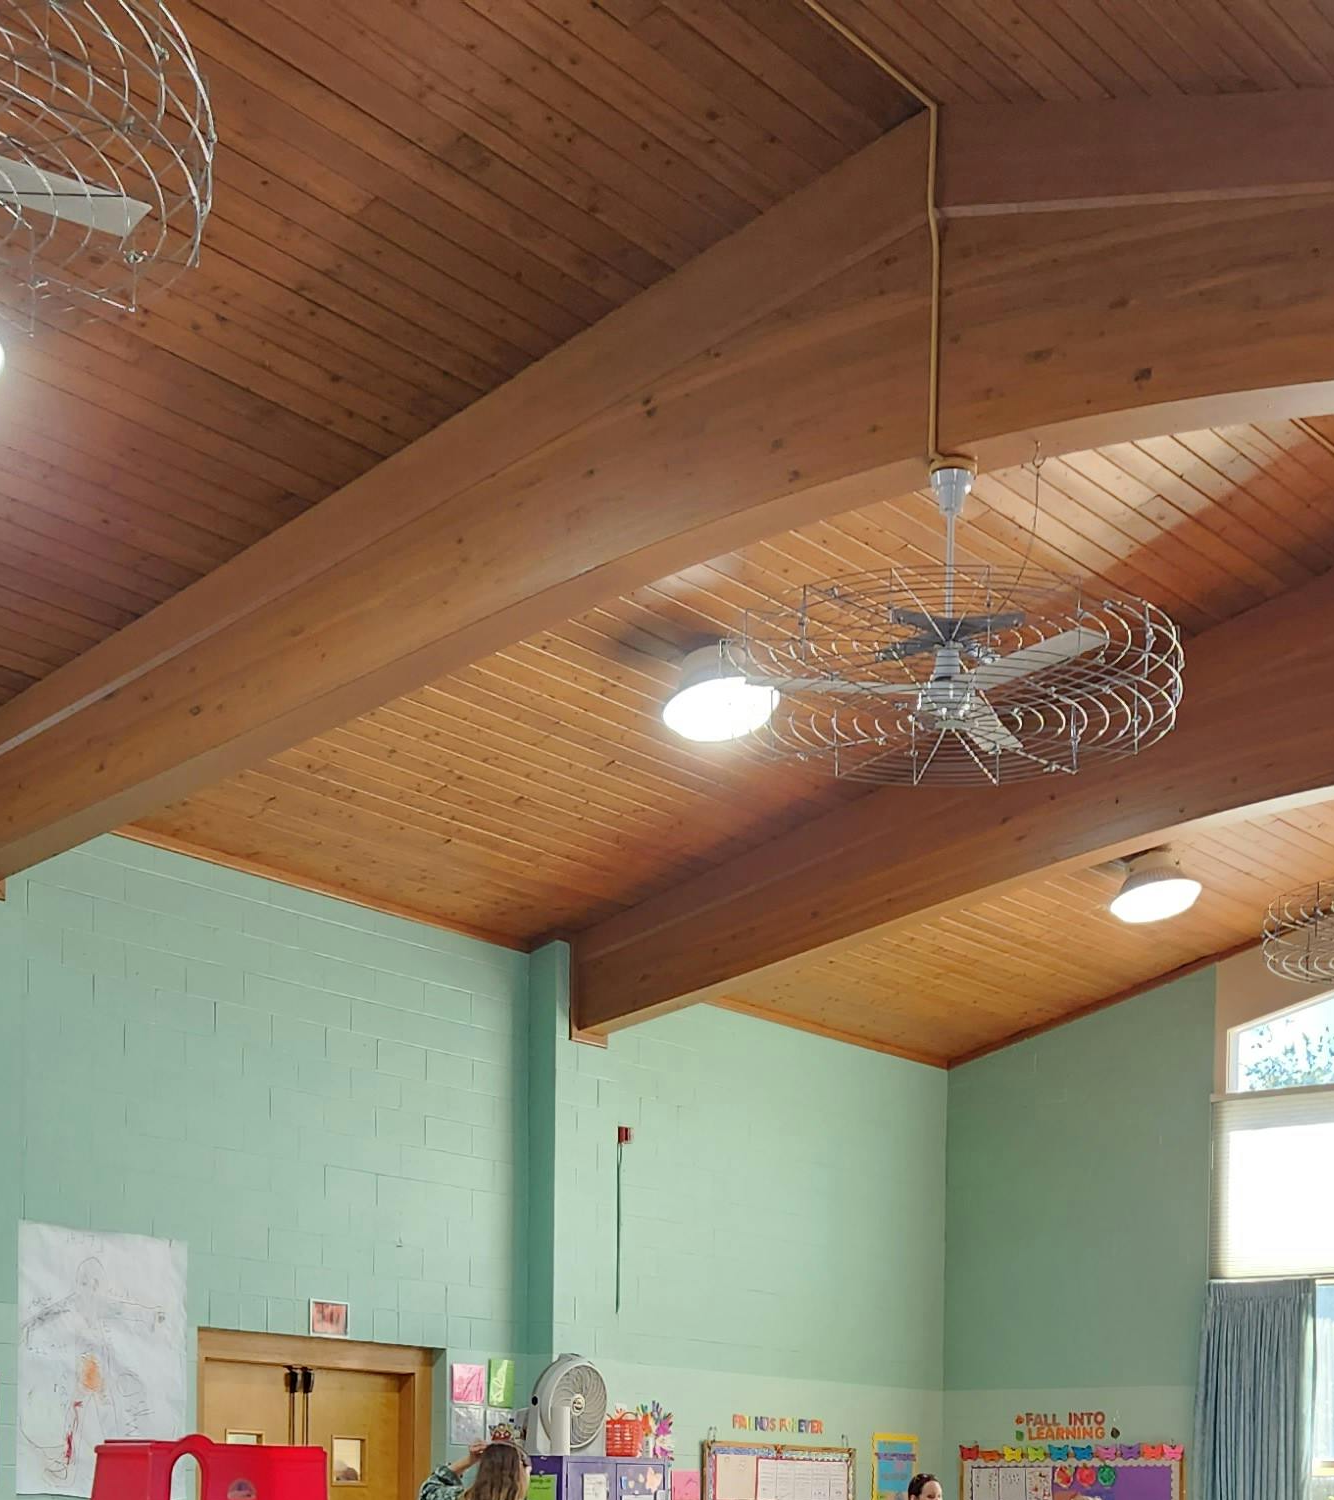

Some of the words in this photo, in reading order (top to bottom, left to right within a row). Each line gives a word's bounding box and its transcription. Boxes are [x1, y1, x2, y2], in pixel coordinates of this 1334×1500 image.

[1025, 1412, 1061, 1427] FALL
[1068, 1411, 1106, 1426] INTO
[1028, 1426, 1106, 1441] LEARNING
